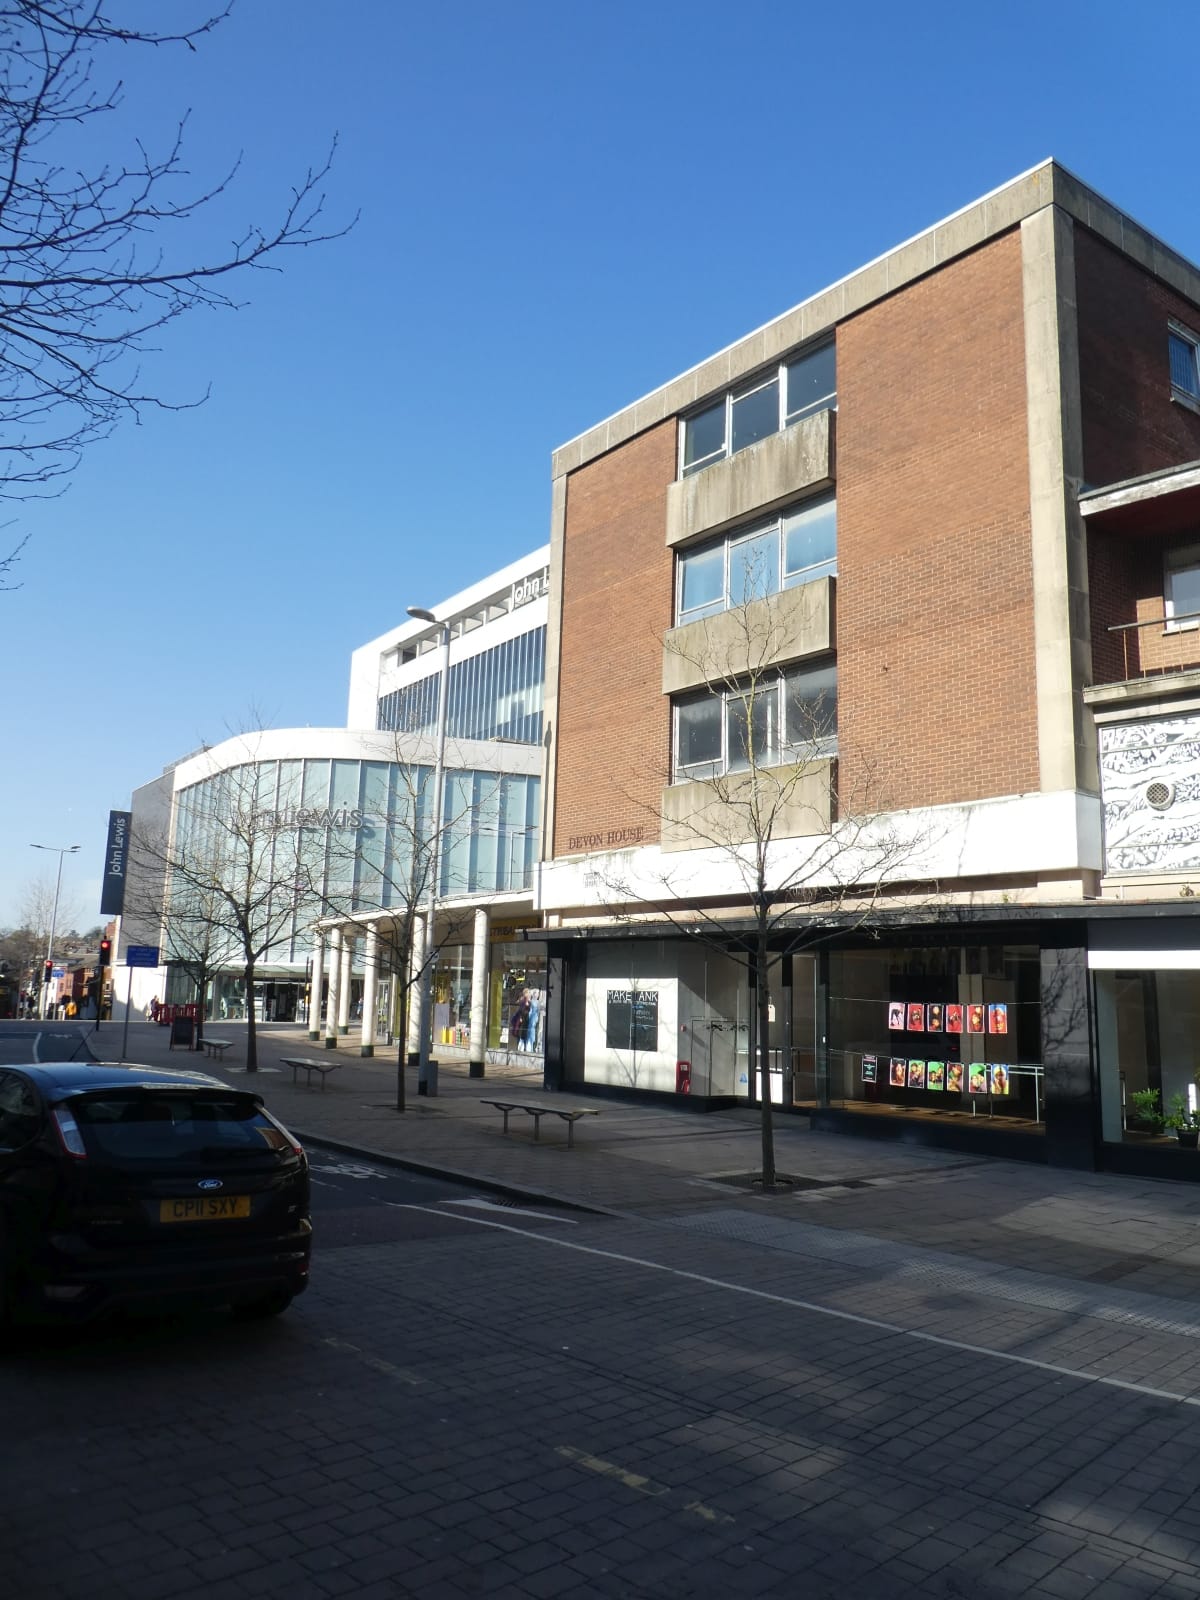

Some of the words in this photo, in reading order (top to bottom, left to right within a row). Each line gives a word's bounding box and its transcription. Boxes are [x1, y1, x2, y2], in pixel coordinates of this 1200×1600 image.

[508, 577, 540, 614] John
[111, 818, 126, 848] Lewis
[568, 833, 603, 850] DEVON
[607, 826, 644, 844] HOUSE
[108, 850, 123, 877] John
[174, 1199, 203, 1217] CP11
[208, 1197, 237, 1216] SXY
